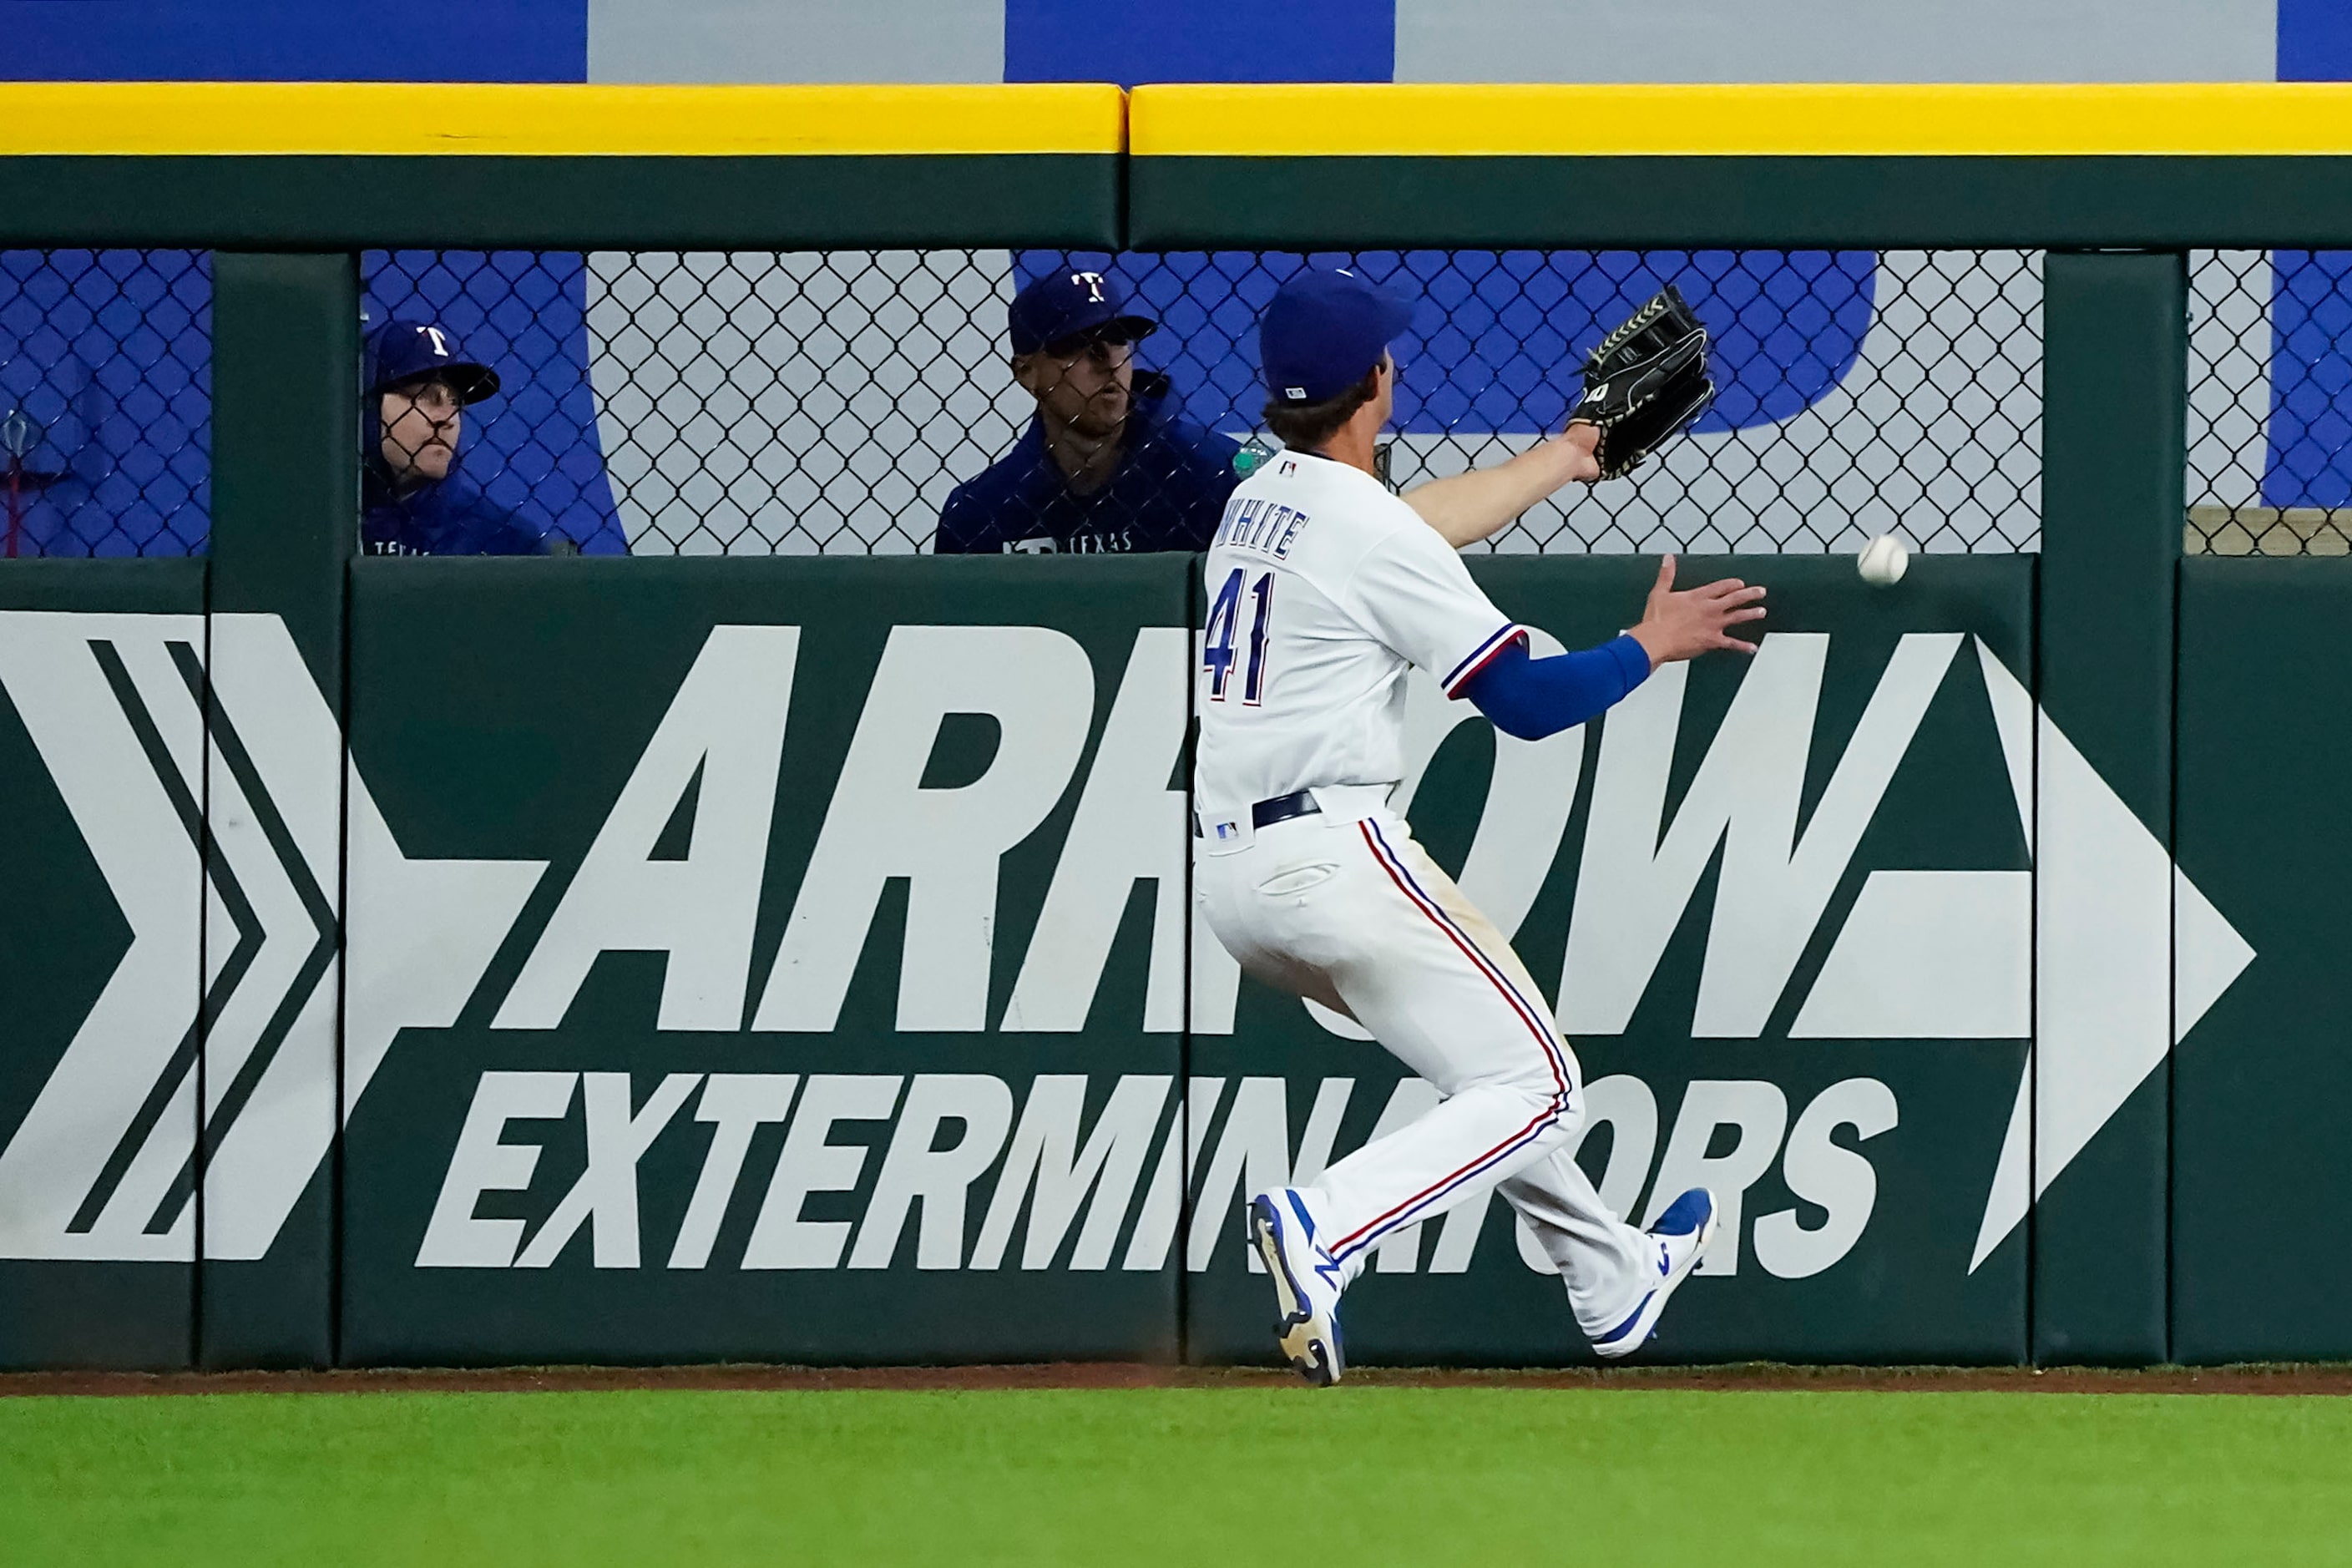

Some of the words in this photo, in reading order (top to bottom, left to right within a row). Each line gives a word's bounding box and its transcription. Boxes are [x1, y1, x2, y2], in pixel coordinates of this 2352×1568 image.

[1070, 271, 1105, 303] T
[416, 326, 449, 357] T
[1214, 498, 1310, 561] WHITE
[1203, 568, 1276, 706] 41
